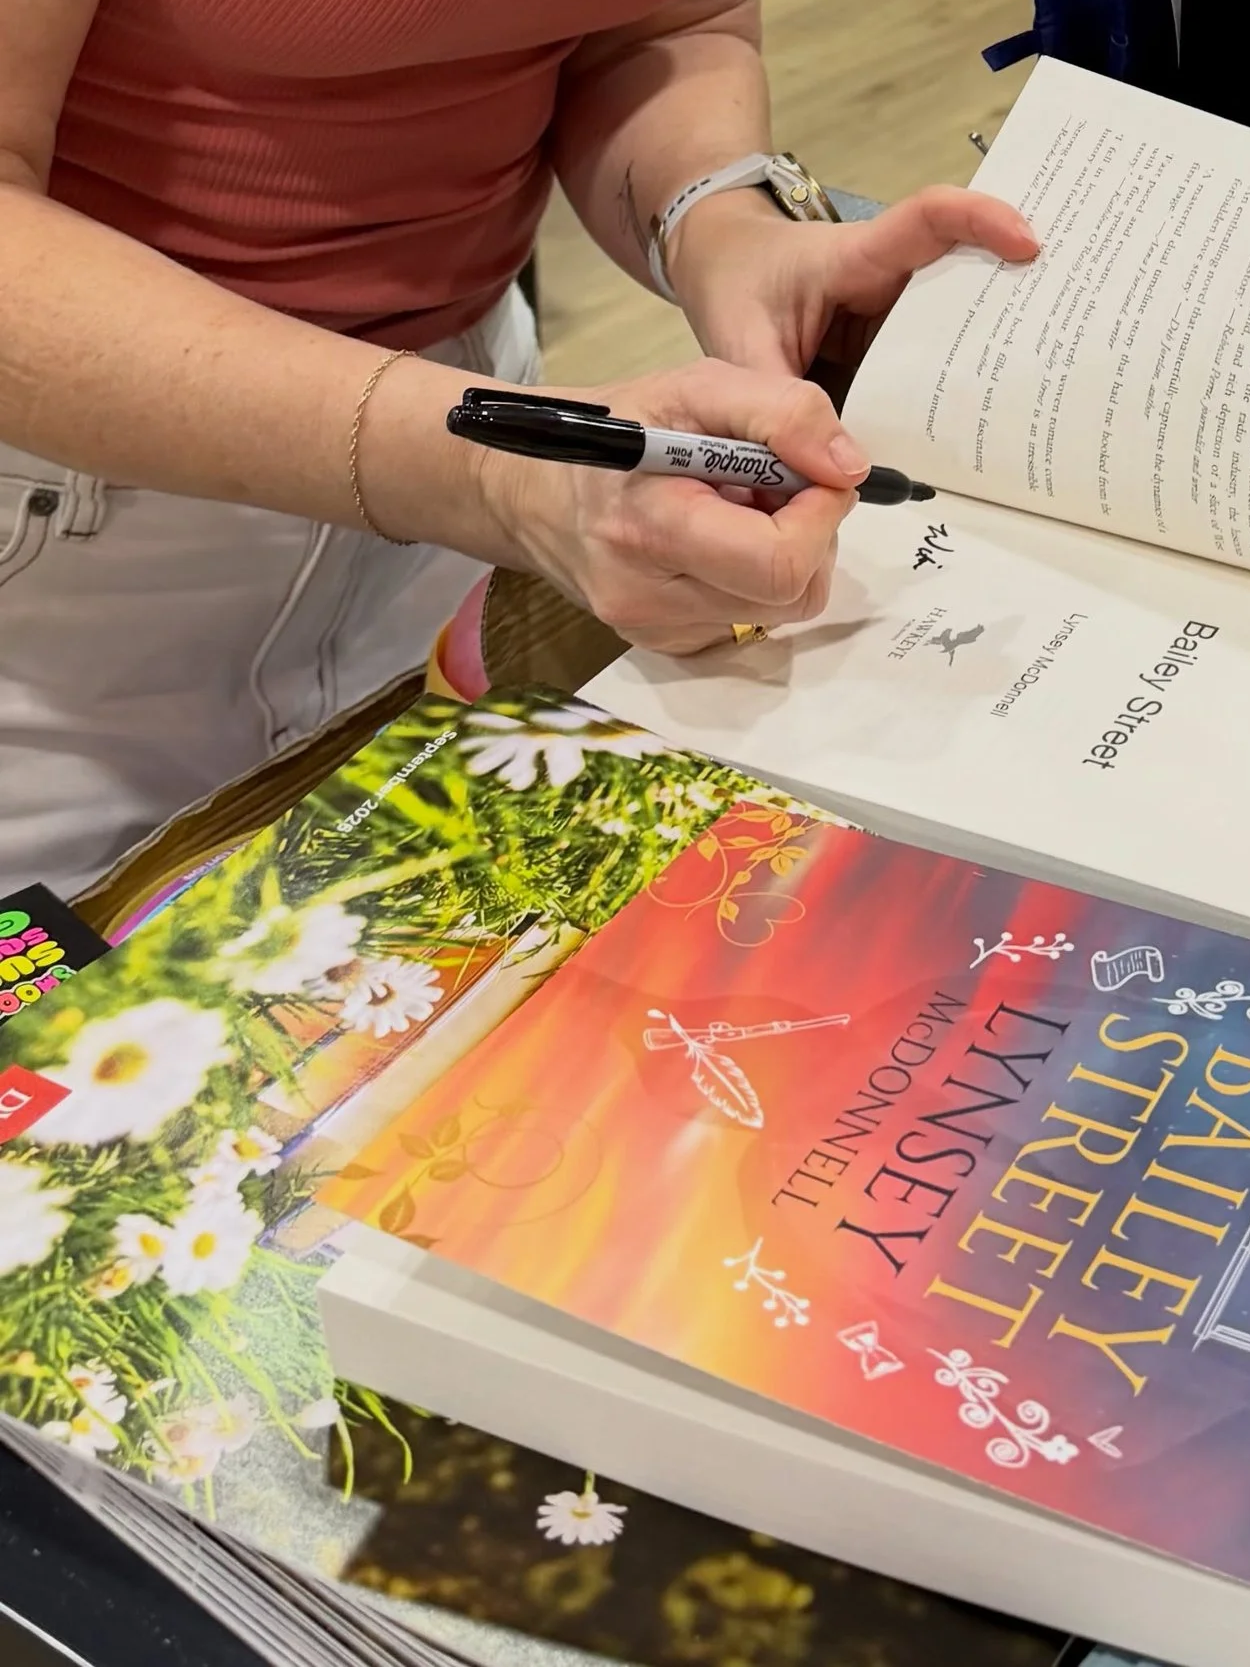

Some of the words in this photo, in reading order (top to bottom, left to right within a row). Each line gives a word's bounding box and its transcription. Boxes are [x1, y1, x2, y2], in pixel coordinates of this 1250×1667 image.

[1118, 213, 1137, 238] and
[1170, 181, 1207, 237] masterful
[1206, 177, 1242, 235] forbidden
[1087, 208, 1129, 268] sprinkling
[1155, 239, 1176, 266] dual
[1192, 234, 1217, 262] love
[1135, 266, 1166, 317] timeline
[1193, 268, 1216, 305] novel
[1079, 297, 1096, 321] this
[1181, 305, 1204, 330] that
[943, 308, 980, 367] passionate
[1000, 315, 1024, 348] book
[1060, 321, 1087, 370] cleverly
[1122, 317, 1143, 350] story
[987, 349, 1007, 382] filled
[1115, 351, 1132, 379] that
[1161, 328, 1192, 400] masterfully
[1231, 341, 1249, 370] and
[935, 369, 948, 393] and
[980, 386, 994, 413] with
[1050, 373, 1068, 414] woven
[1107, 380, 1123, 405] had
[1143, 381, 1162, 420] author
[1220, 370, 1242, 401] rich
[1042, 413, 1057, 466] romance
[1152, 398, 1171, 451] captures
[1210, 400, 1234, 461] depiction
[664, 445, 694, 458] POINT
[669, 456, 691, 470] FINE
[704, 447, 785, 488] Sharpie
[1098, 429, 1113, 474] hooked
[887, 607, 947, 662] HAWKEYE
[1040, 613, 1088, 655] Lynsey
[1139, 620, 1220, 692] Bailey
[990, 655, 1054, 717] McDonnell
[1082, 697, 1163, 769] Street
[378, 729, 458, 805] September
[771, 989, 969, 1210] McDONNELL
[834, 1000, 1071, 1277] LYNSEY
[923, 1011, 1189, 1349] STREET
